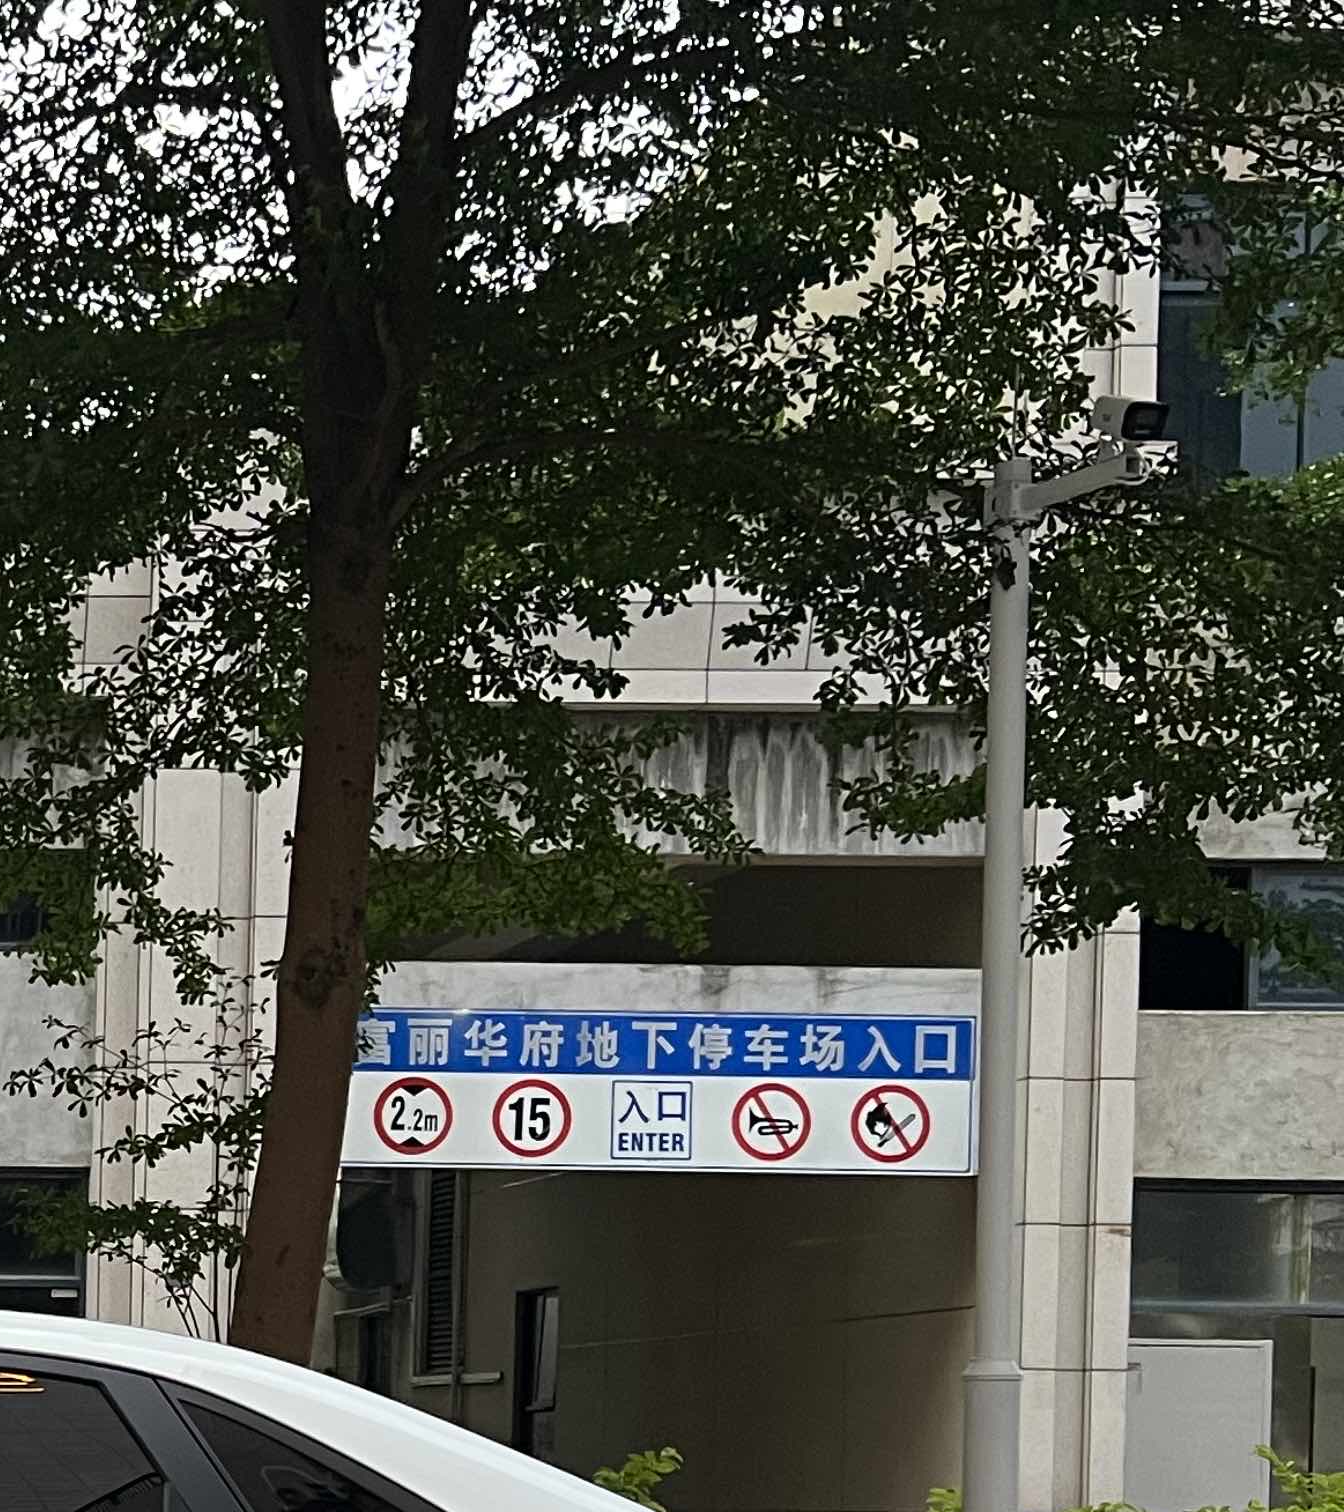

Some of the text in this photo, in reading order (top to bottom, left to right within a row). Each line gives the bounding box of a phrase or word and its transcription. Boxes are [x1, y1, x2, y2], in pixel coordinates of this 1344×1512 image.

[390, 1094, 439, 1133] 2.2m
[508, 1096, 551, 1141] 15
[618, 1089, 688, 1123] 入口
[618, 1131, 685, 1153] ENTER
